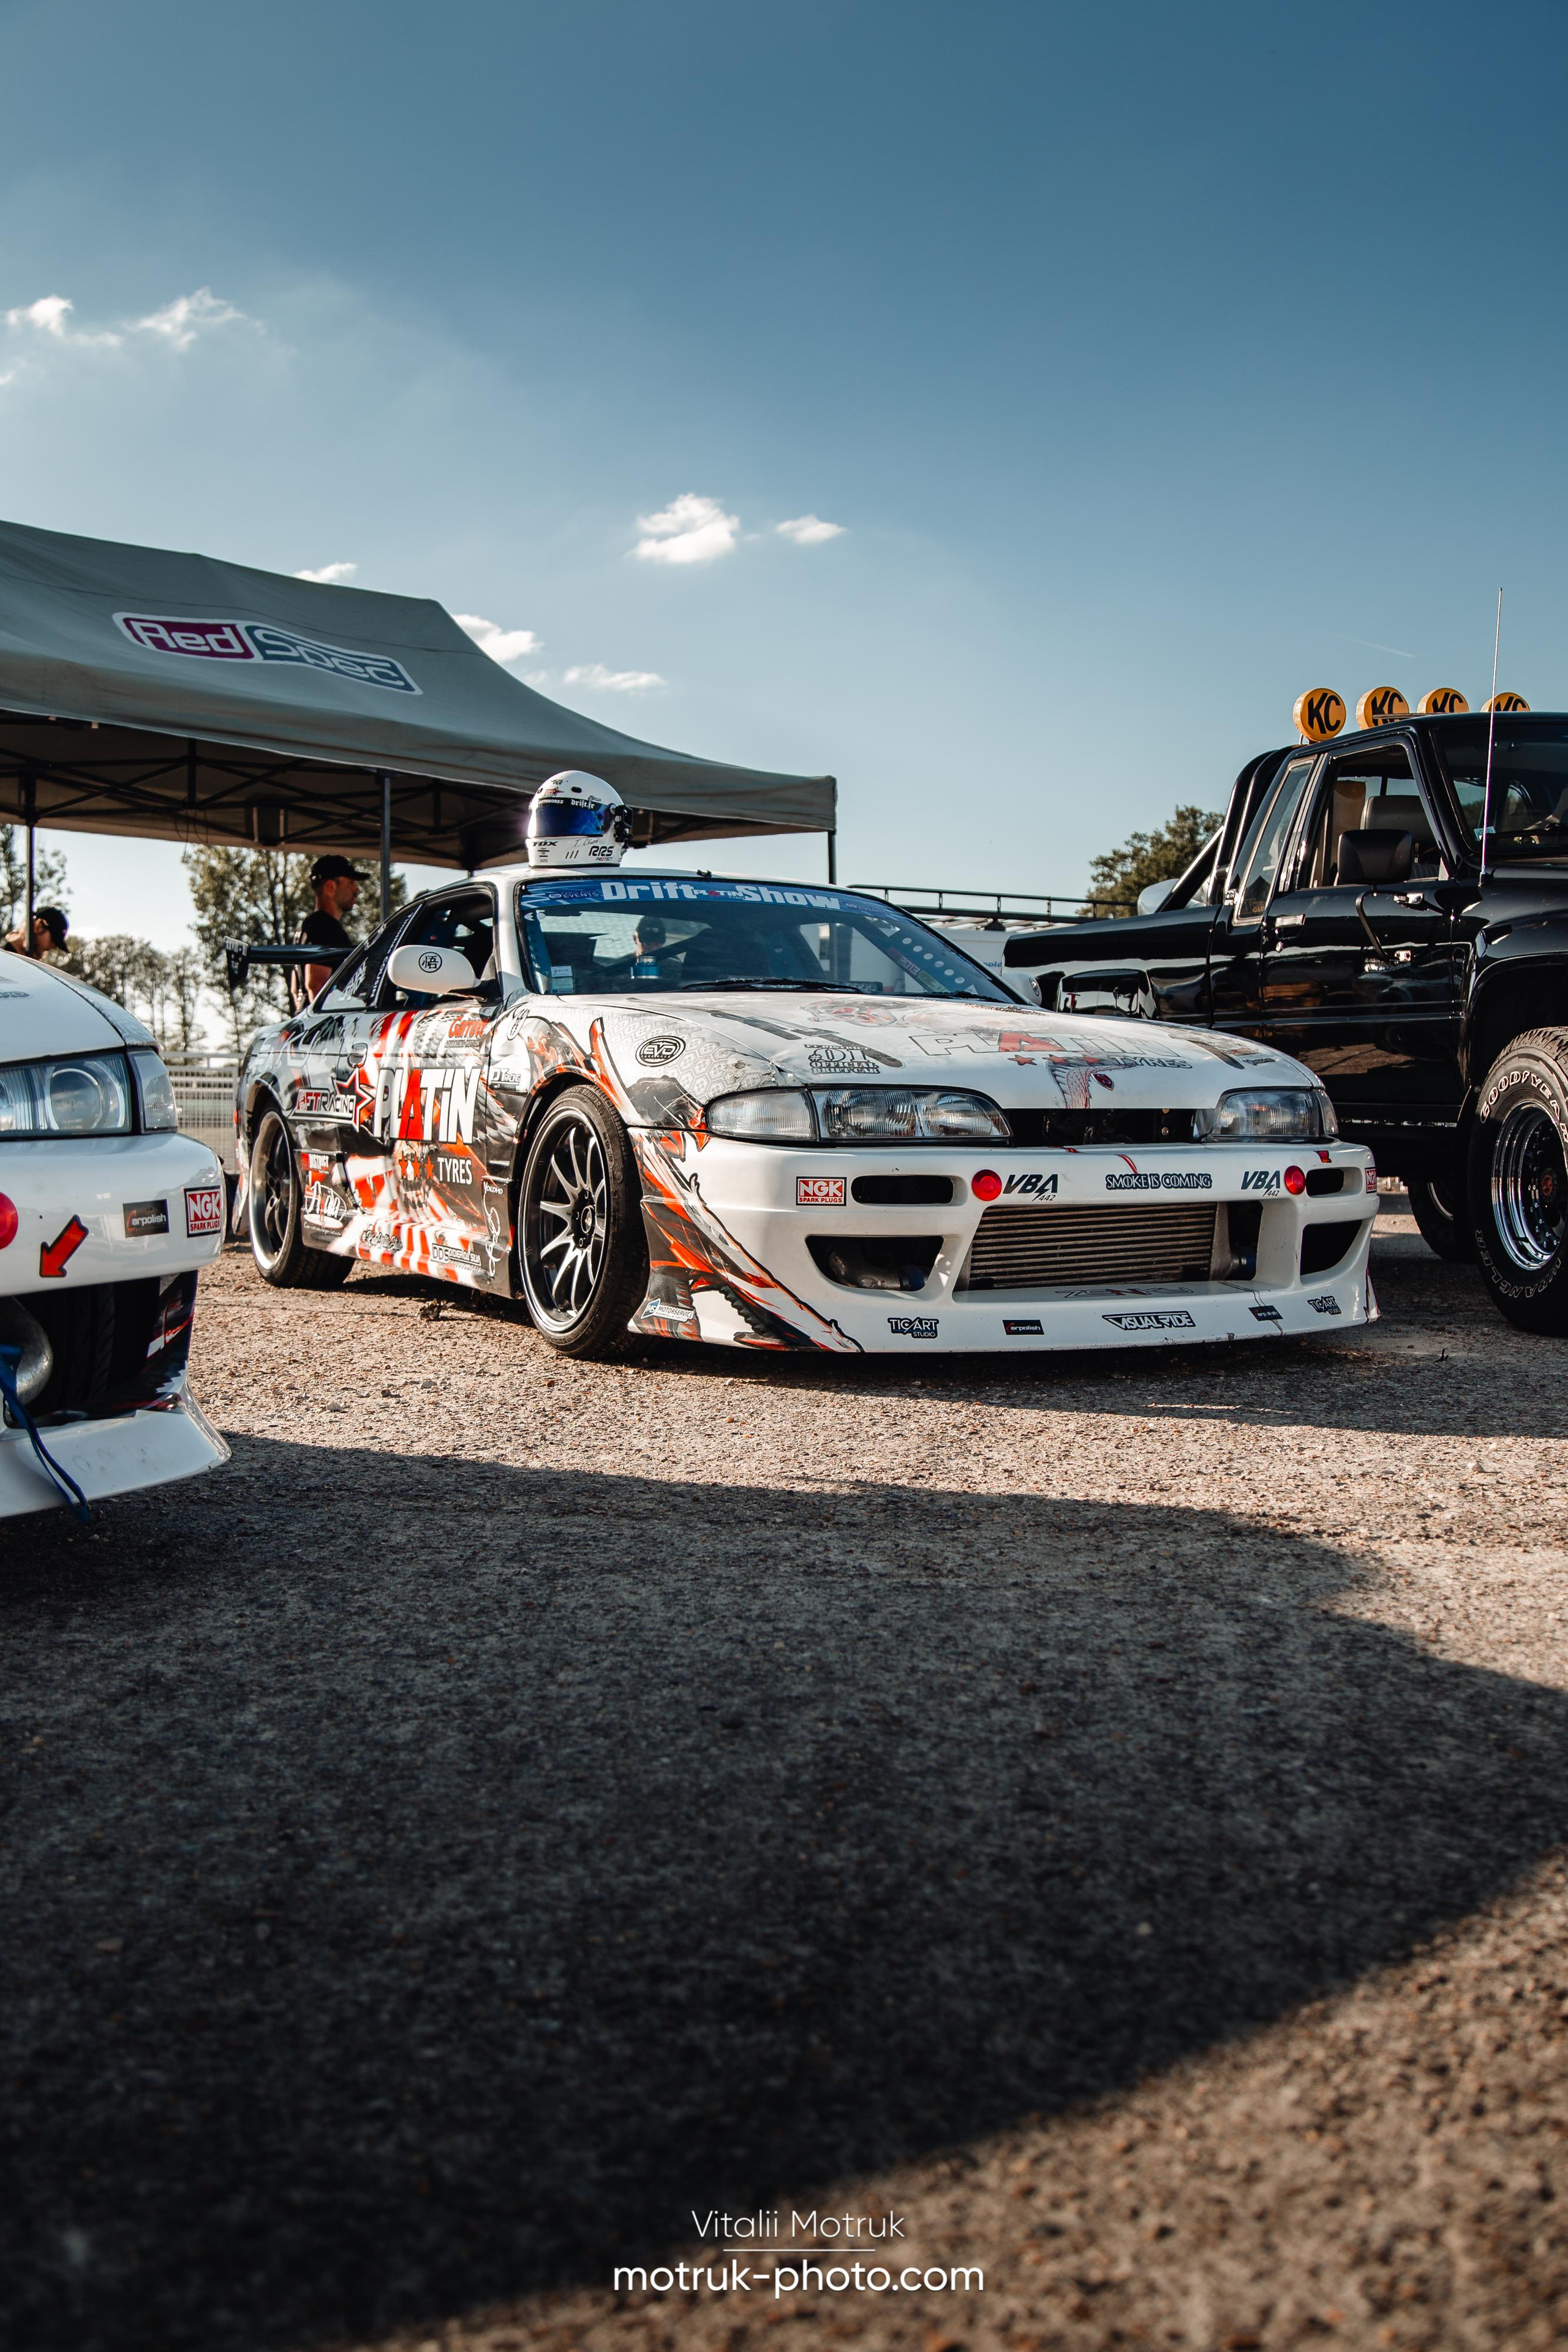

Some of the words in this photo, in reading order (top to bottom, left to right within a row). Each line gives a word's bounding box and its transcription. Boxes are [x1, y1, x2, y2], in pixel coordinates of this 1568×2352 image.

[130, 620, 244, 654] Red
[254, 627, 405, 687] Spec
[1308, 692, 1341, 734] KC
[589, 845, 614, 857] RRS
[601, 881, 698, 900] Drift
[735, 885, 840, 910] Show
[421, 955, 439, 969] 悟
[643, 1041, 677, 1058] EVO
[908, 1031, 1180, 1057] PLATIN
[1112, 1055, 1193, 1069] TYRES
[374, 1068, 482, 1144] PLATIN
[437, 1156, 473, 1185] TYRES
[483, 1181, 503, 1195] YOKOMO
[799, 1180, 843, 1197] NGK
[1003, 1174, 1058, 1196] VBA
[1106, 1175, 1148, 1188] SMOKE
[1150, 1175, 1160, 1188] IS
[1163, 1175, 1211, 1188] COMING
[1241, 1170, 1281, 1191] VBA
[189, 1192, 221, 1221] NGK
[190, 1222, 207, 1232] SPARK
[206, 1219, 221, 1230] PLUGS
[432, 1246, 450, 1262] DDS
[658, 1306, 693, 1318] MOTORSERVICE
